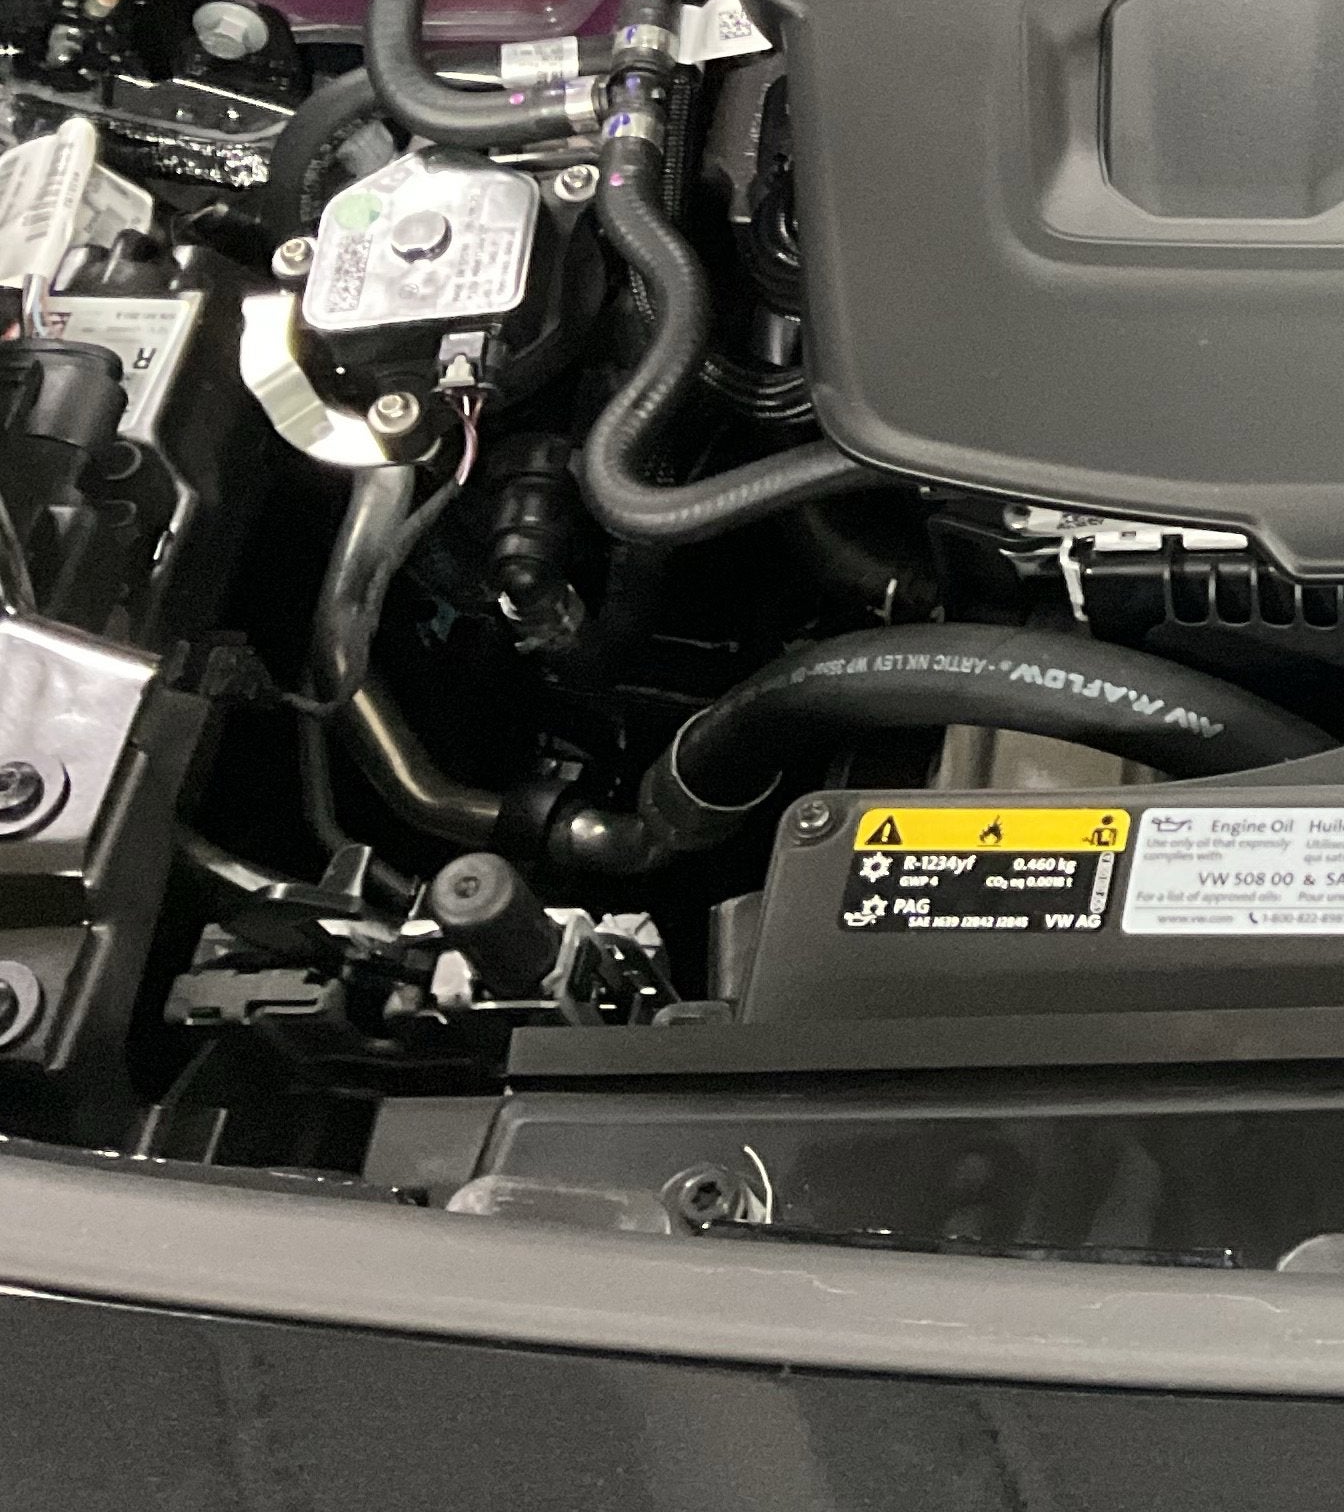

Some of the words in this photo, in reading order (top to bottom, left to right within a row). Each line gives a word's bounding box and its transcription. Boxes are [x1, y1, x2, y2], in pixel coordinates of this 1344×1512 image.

[133, 347, 157, 369] R
[933, 654, 987, 674] ARTIC
[1211, 819, 1267, 836] Engine
[1270, 819, 1294, 833] Oil
[1147, 839, 1168, 849] Use
[1169, 839, 1193, 851] only
[1196, 839, 1211, 848] oil
[1213, 839, 1235, 848] that
[1238, 839, 1292, 851] expressly
[1143, 851, 1194, 863] complies
[1196, 851, 1223, 861] with
[1304, 853, 1323, 865] qui
[903, 854, 977, 875] R-1234yf
[1013, 857, 1055, 871] 0.460
[1056, 858, 1077, 875] kg
[1199, 872, 1230, 886] VW
[1233, 872, 1266, 886] 508
[1270, 872, 1294, 886] 00
[1303, 874, 1316, 886] &
[1136, 891, 1156, 902] For
[1157, 893, 1165, 902] a
[1167, 891, 1184, 902] list
[1187, 891, 1200, 902] of
[1202, 891, 1256, 904] approved
[1298, 891, 1325, 902] Pour
[893, 898, 931, 915] PAG
[908, 916, 931, 928] SAE
[1045, 914, 1074, 929] VW
[1075, 914, 1101, 929] AG
